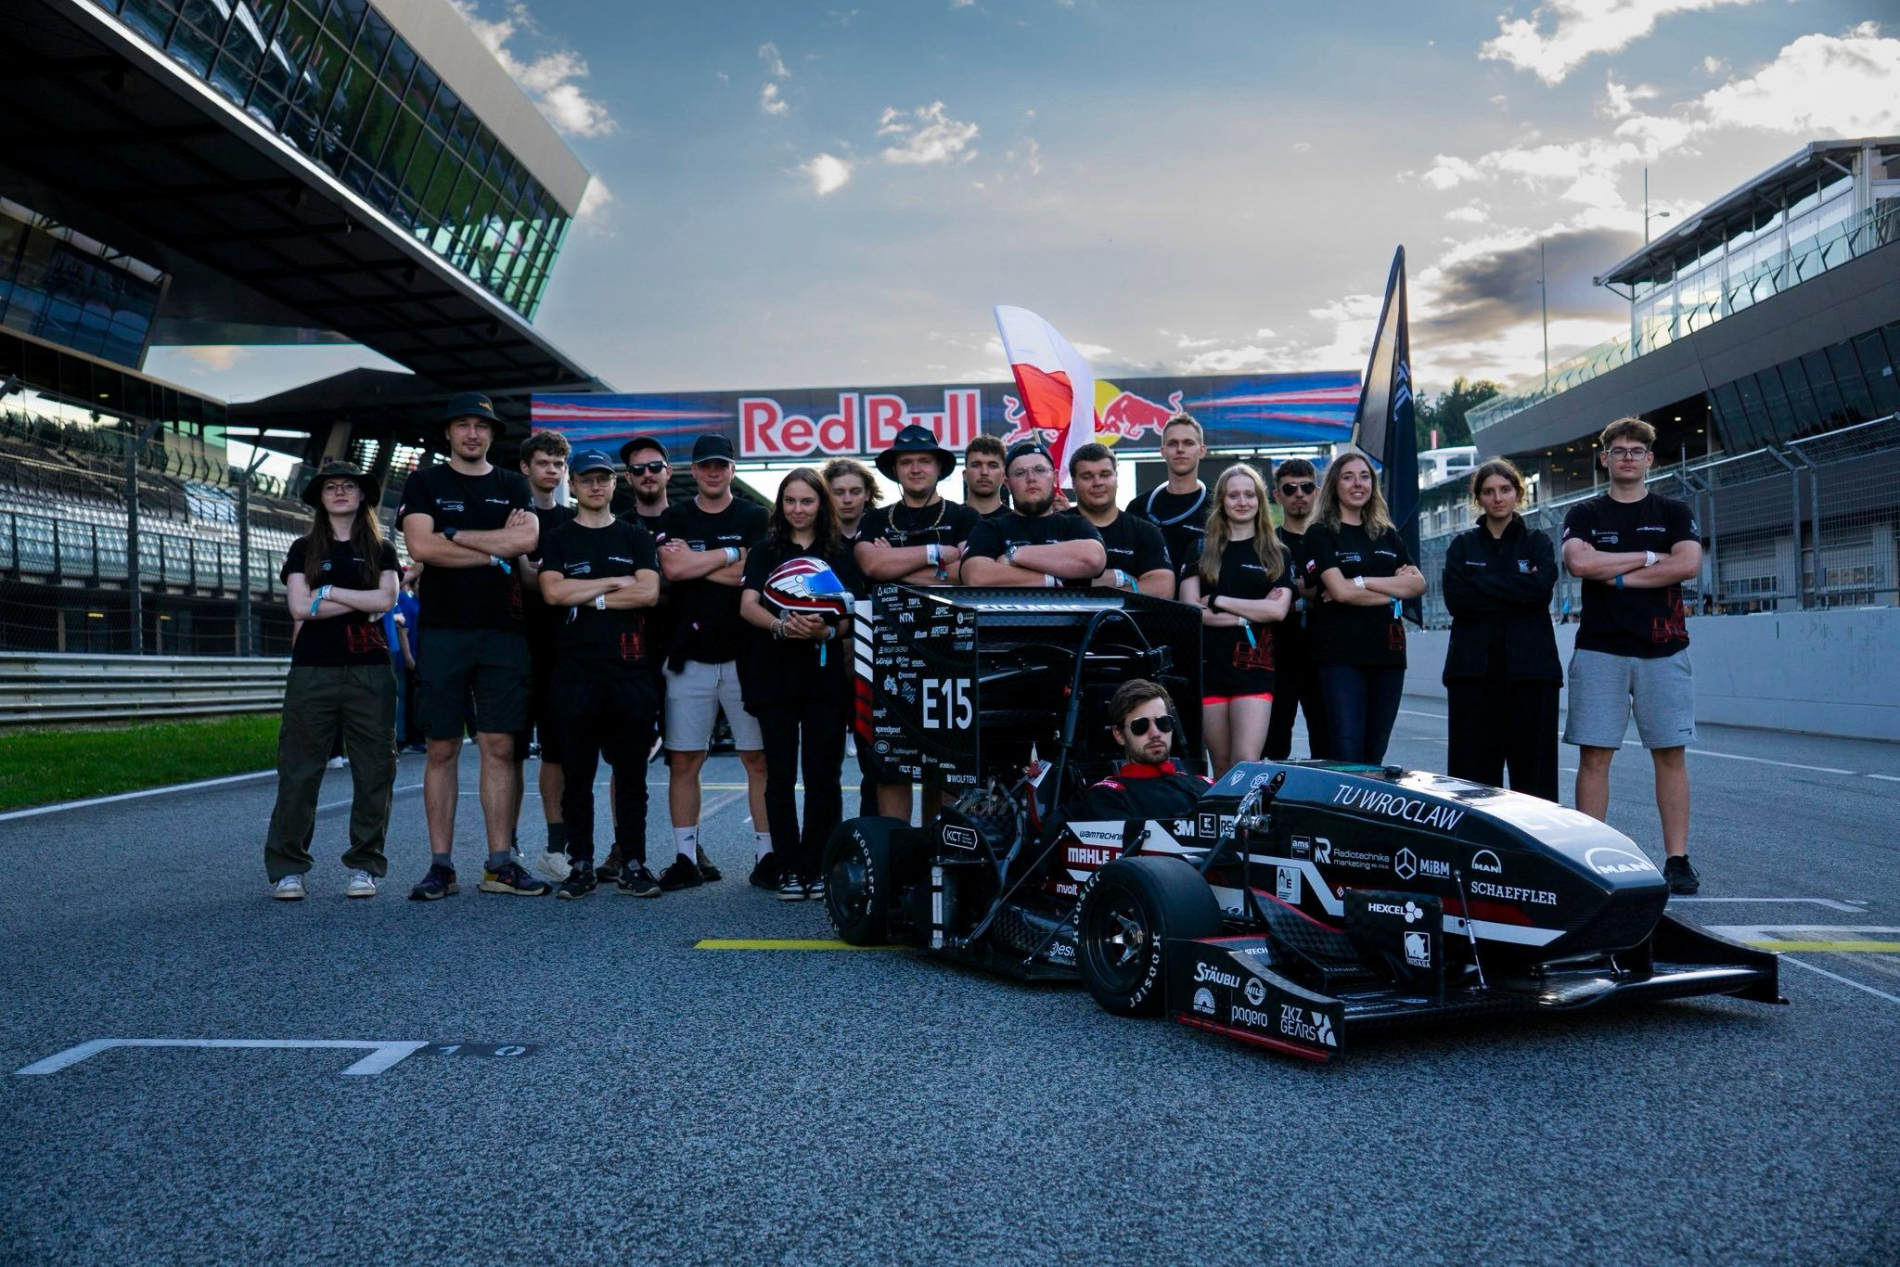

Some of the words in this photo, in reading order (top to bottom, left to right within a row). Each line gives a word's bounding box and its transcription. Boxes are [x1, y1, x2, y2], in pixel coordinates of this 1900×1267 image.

[742, 395, 857, 454] Red
[899, 612, 914, 623] NTN
[922, 678, 973, 730] E15
[951, 775, 977, 784] WOLFTEN
[1332, 784, 1356, 807] TU
[1358, 788, 1464, 831] WROCLAW
[946, 830, 962, 842] KCT
[1173, 819, 1195, 837] 3M
[1292, 839, 1310, 849] ams
[1067, 847, 1110, 865] MAHLE
[1333, 848, 1390, 862] Radiotechnika
[1333, 859, 1371, 870] marketing
[1420, 858, 1450, 876] MiBM
[1471, 862, 1501, 873] MAN
[1597, 862, 1657, 874] MAN
[1470, 880, 1557, 905] SCHAEFFLER
[1367, 902, 1406, 915] HEXCEL
[1193, 961, 1241, 988] STÄUBLI
[1245, 984, 1265, 996] NILS
[1231, 1005, 1268, 1027] pagero
[1280, 1003, 1303, 1024] ZKZ
[1280, 1019, 1317, 1042] GEARS
